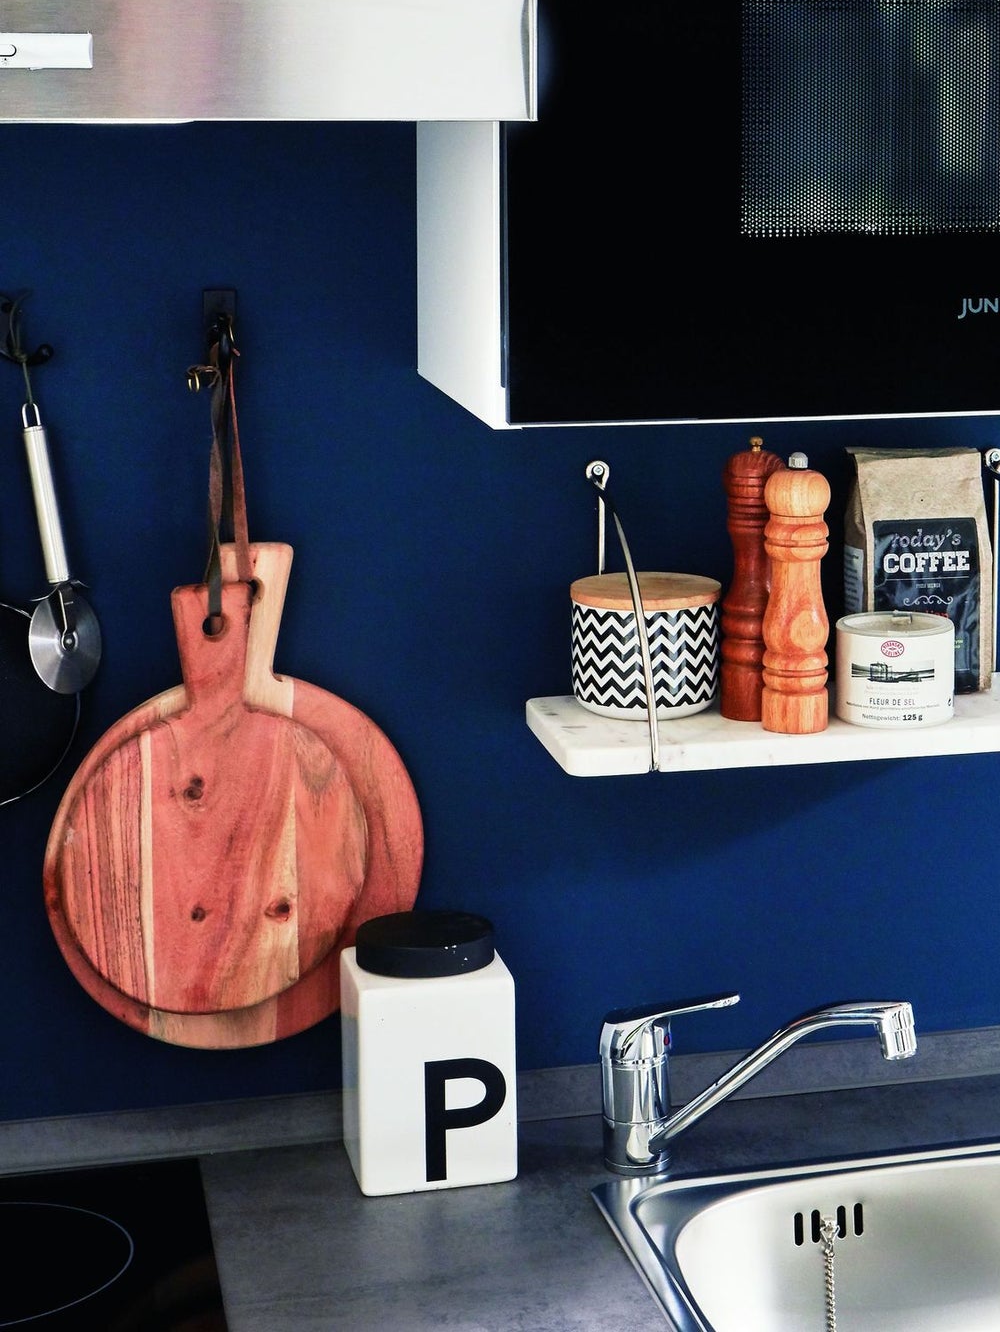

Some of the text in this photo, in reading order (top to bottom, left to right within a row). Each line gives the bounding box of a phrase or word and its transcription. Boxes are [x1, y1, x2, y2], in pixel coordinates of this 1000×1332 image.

[882, 550, 970, 574] COFFEE
[869, 697, 889, 705] FLEUR
[892, 698, 901, 706] DE
[903, 698, 916, 706] SEL
[424, 1057, 506, 1182] P
